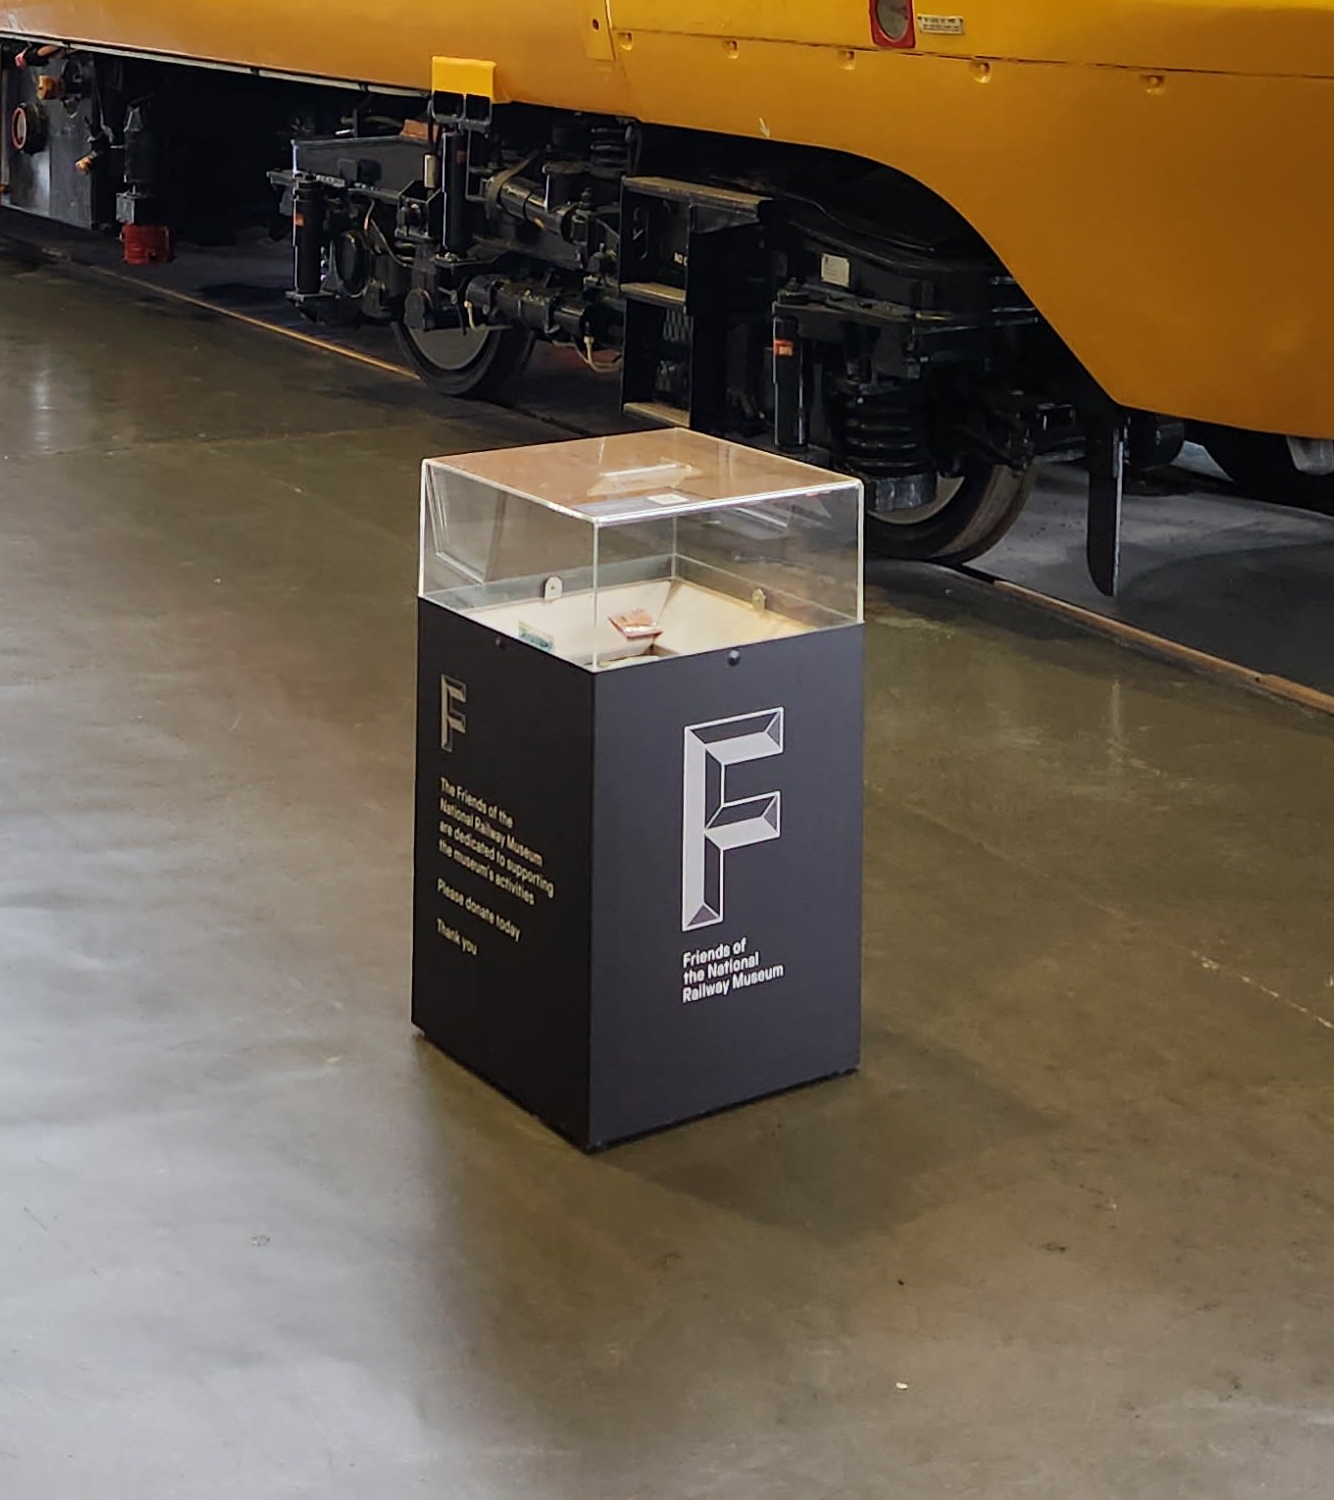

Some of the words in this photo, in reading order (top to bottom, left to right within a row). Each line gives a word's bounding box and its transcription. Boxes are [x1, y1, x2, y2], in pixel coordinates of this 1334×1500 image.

[440, 673, 467, 753] F
[440, 776, 455, 797] The
[456, 785, 487, 815] Friends
[488, 804, 498, 819] of
[498, 810, 514, 829] the
[440, 798, 474, 828] National
[474, 816, 506, 848] Railway
[506, 834, 543, 867] Museum
[682, 707, 785, 932] F
[439, 820, 453, 837] are
[454, 825, 495, 861] dedicated
[496, 850, 507, 867] to
[507, 858, 555, 899] supporting
[439, 838, 453, 858] the
[453, 848, 494, 882] museum's
[495, 872, 535, 906] activities
[436, 917, 461, 946] Thank
[461, 935, 478, 956] you
[437, 877, 464, 906] Please
[465, 896, 495, 925] donate
[495, 914, 521, 943] today
[682, 979, 730, 1003] Railway
[732, 965, 784, 989] Museum
[683, 943, 730, 969] Friends
[732, 937, 747, 955] of
[683, 969, 705, 985] the
[707, 951, 759, 980] National
